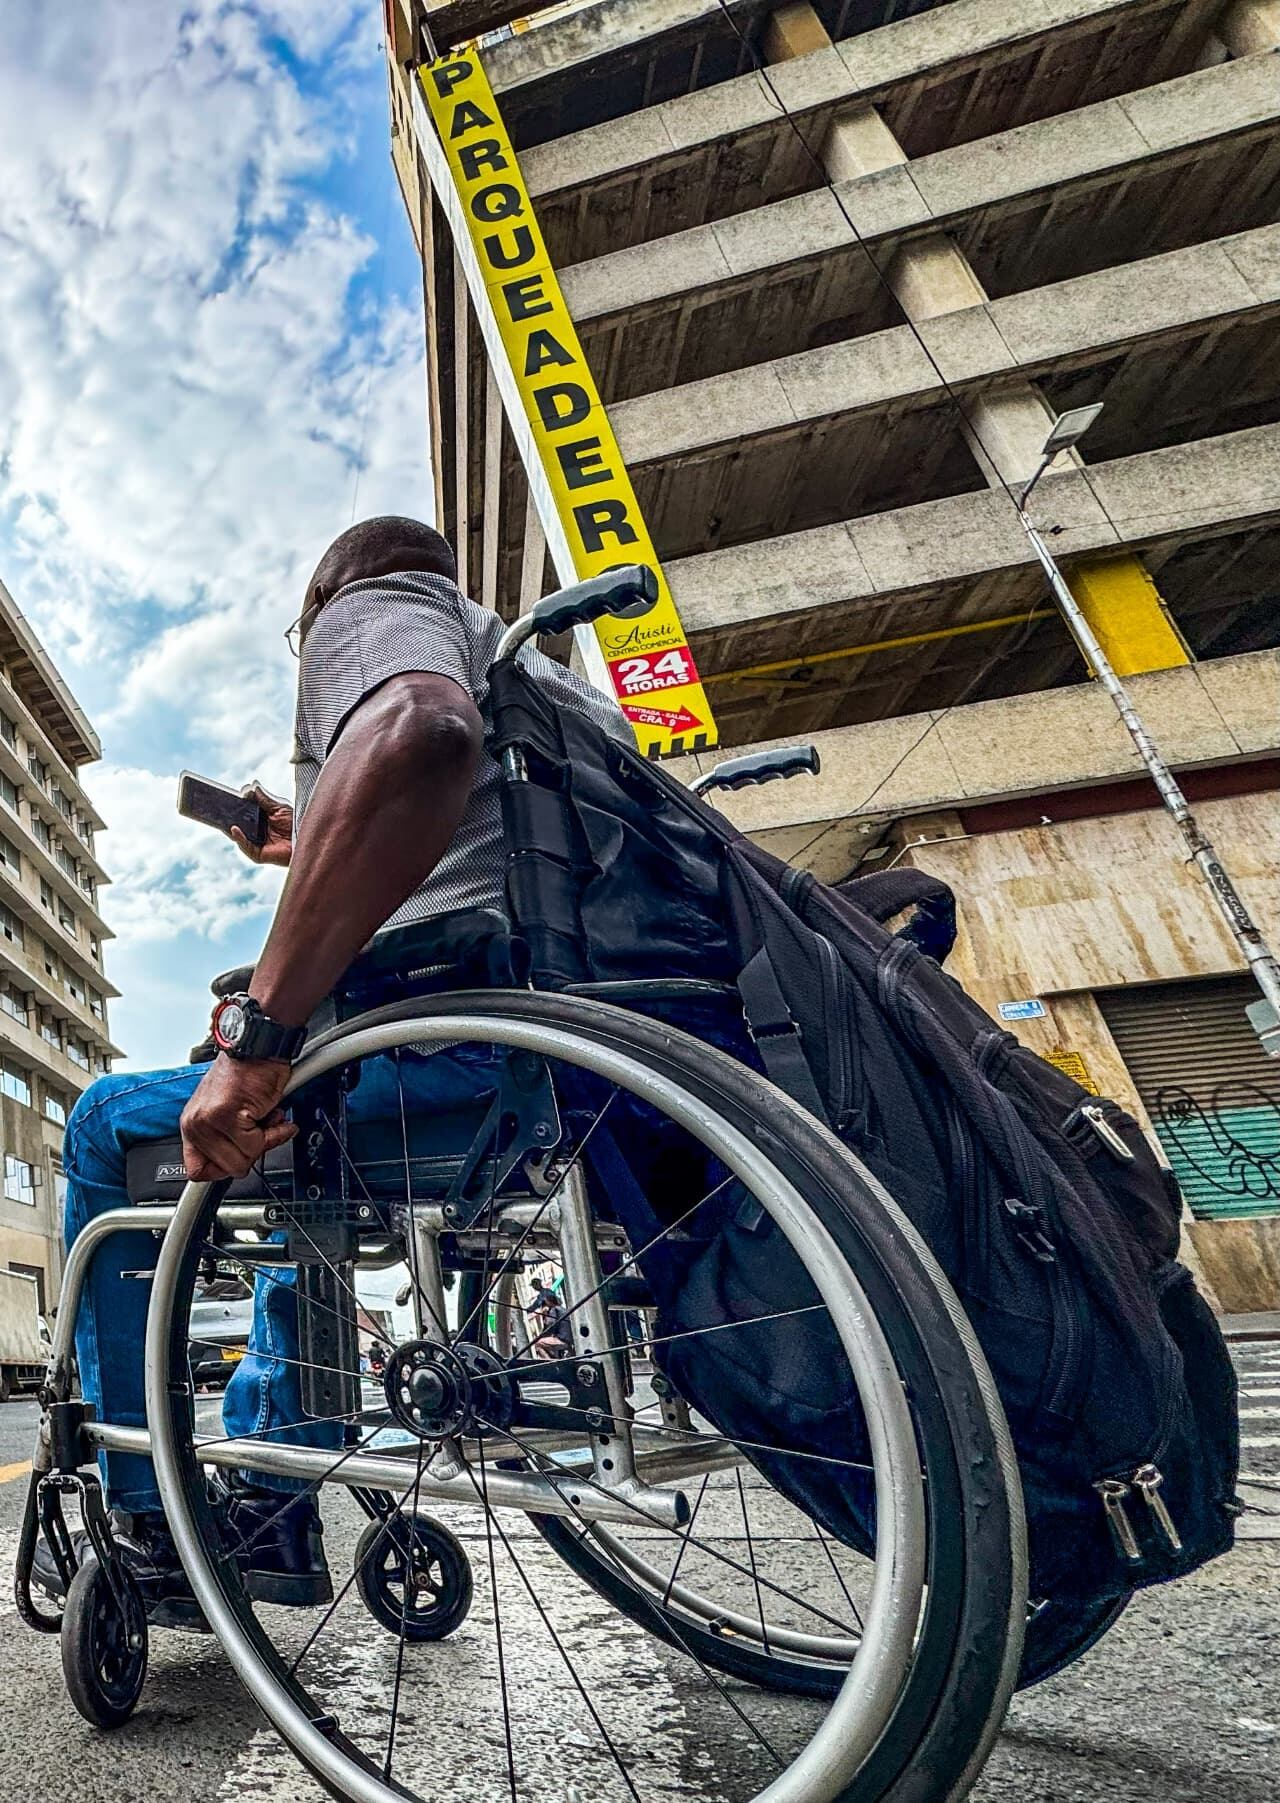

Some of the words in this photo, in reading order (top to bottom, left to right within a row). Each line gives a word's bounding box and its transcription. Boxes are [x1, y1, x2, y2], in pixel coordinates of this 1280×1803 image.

[604, 624, 675, 649] Aristi
[608, 645, 640, 657] CENTRO
[640, 637, 682, 650] COMERCIAL
[617, 650, 689, 685] 24
[625, 673, 690, 694] HORAS
